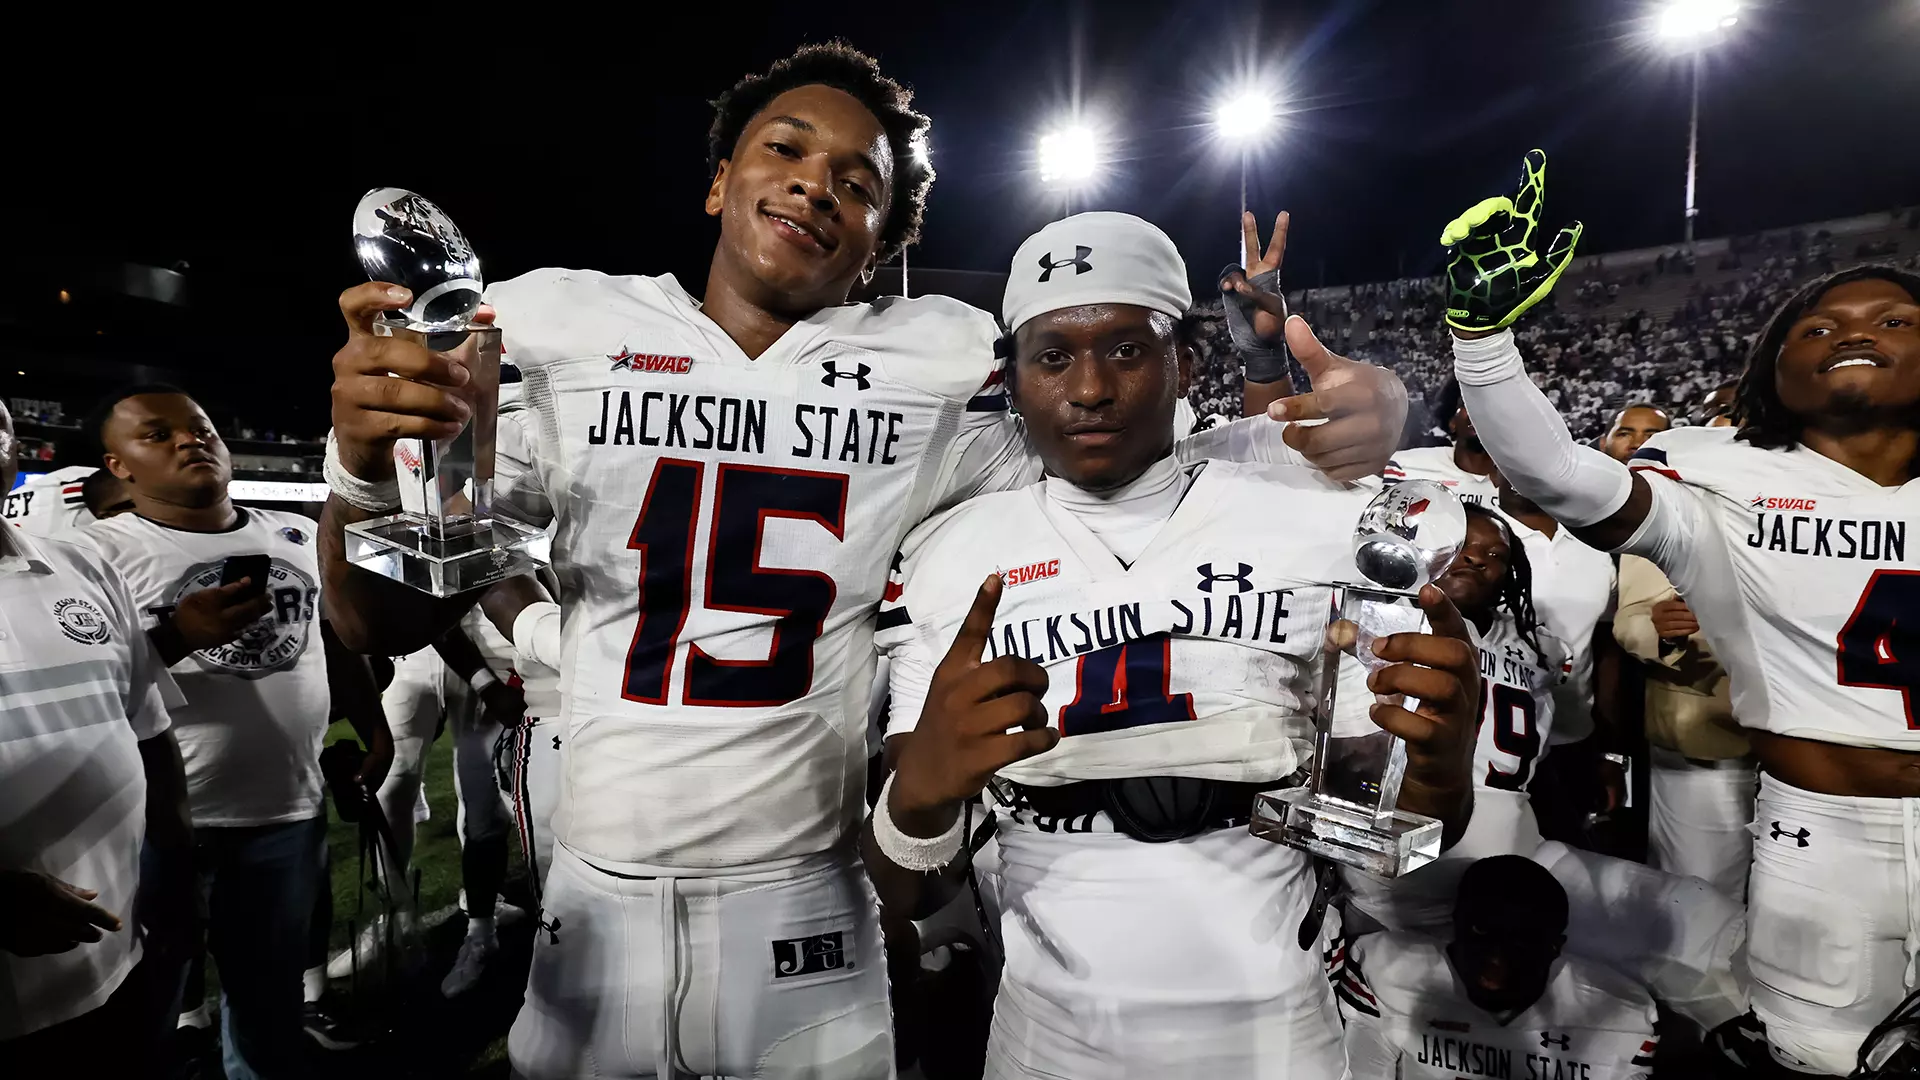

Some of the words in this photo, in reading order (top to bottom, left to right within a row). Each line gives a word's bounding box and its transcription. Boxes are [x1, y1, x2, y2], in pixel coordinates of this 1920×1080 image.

[632, 354, 690, 372] SWAC
[588, 389, 768, 454] JACKSON
[791, 404, 904, 465] STATE
[1766, 497, 1816, 511] SWAC
[1747, 513, 1906, 562] JACKSON
[267, 569, 288, 581] RED
[621, 456, 850, 708] 15
[1008, 559, 1059, 586] SWAC
[1170, 590, 1294, 643] STATE
[203, 645, 262, 666] CKSON
[267, 634, 300, 662] STATE
[1418, 1034, 1512, 1079] JACKSON
